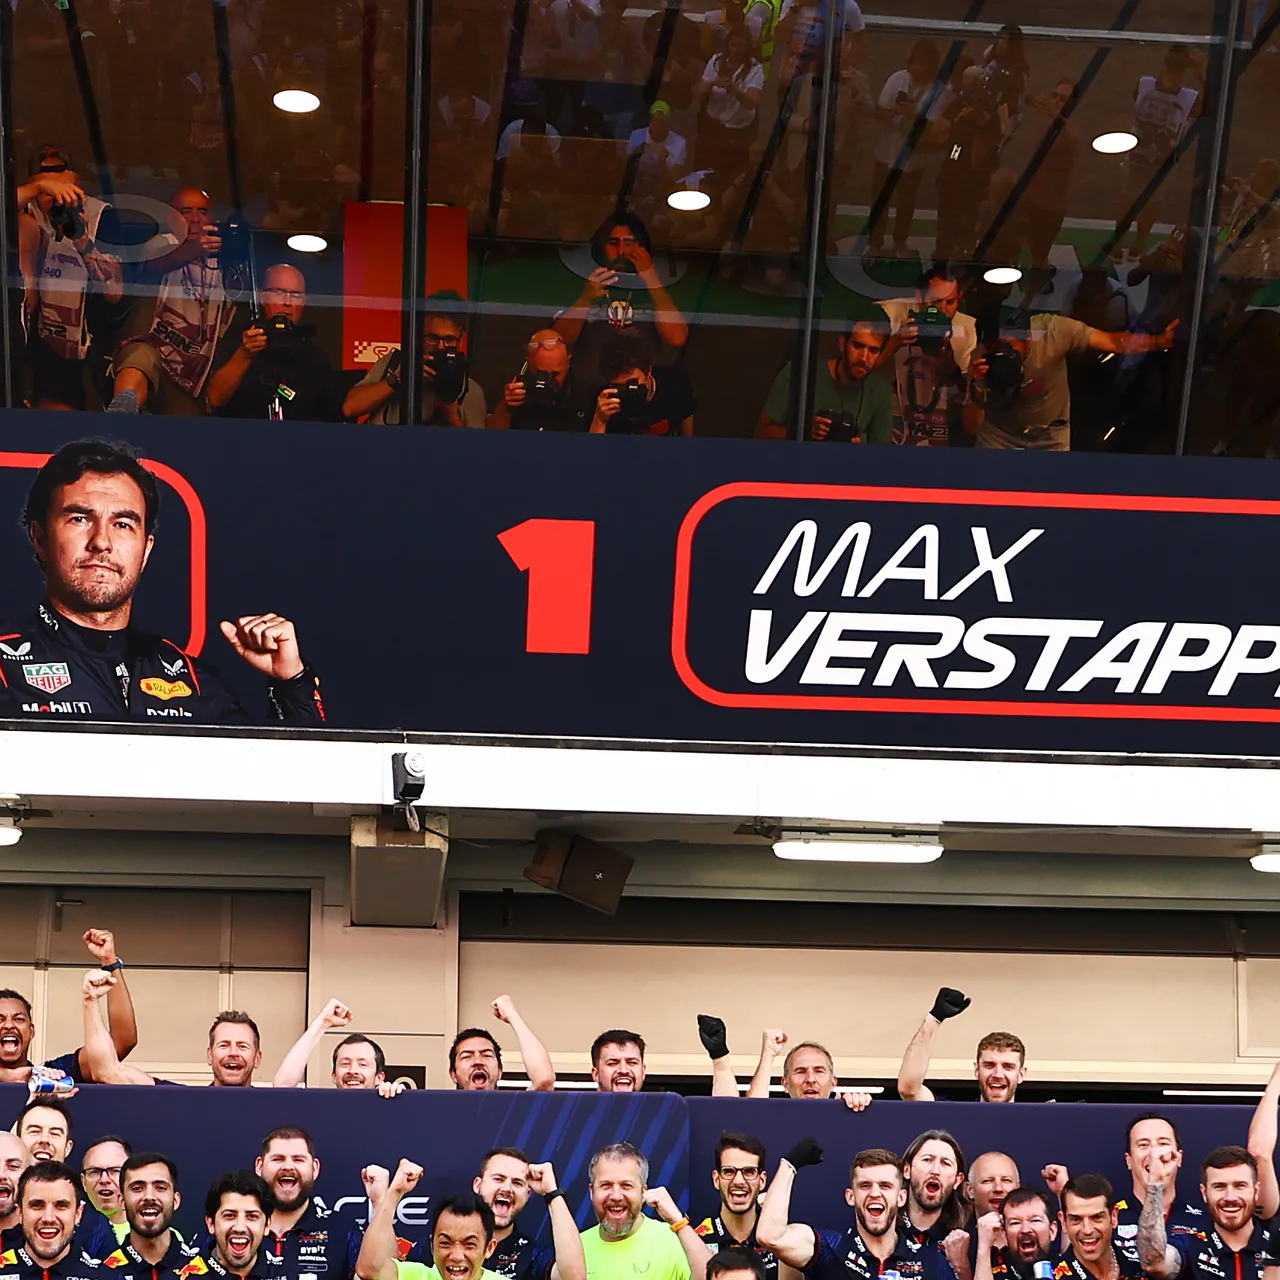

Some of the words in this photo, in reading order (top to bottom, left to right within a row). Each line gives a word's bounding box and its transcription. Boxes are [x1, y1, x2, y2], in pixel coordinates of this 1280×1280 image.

[752, 519, 1044, 603] MAX
[496, 518, 596, 655] 1
[27, 665, 67, 676] TAG
[28, 675, 69, 691] HEUER
[153, 683, 186, 694] RAUCH
[22, 702, 73, 714] Mobil
[715, 1217, 724, 1236] zoom
[18, 1247, 33, 1267] zoom
[126, 1245, 143, 1263] zoom
[300, 1246, 326, 1254] BYBIT
[208, 1257, 227, 1276] zoom
[1072, 1260, 1087, 1280] zoom
